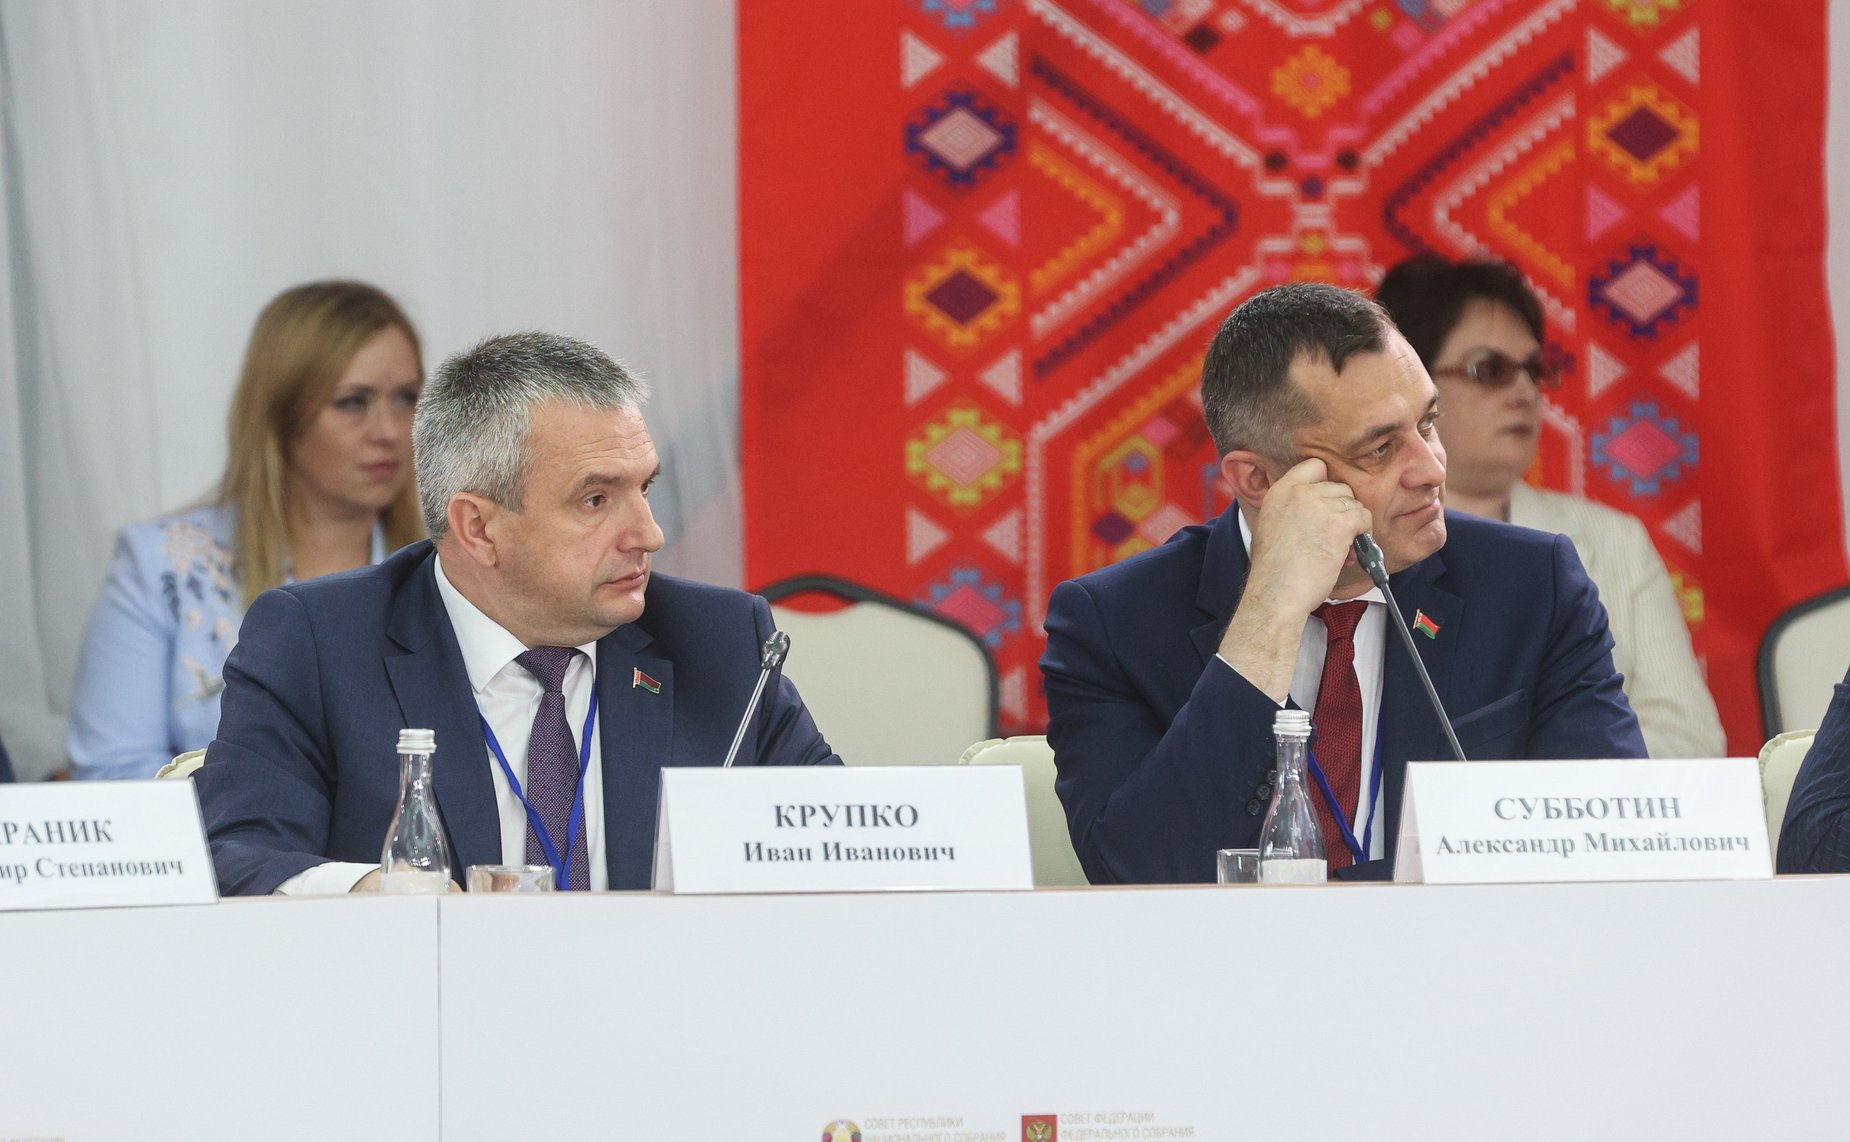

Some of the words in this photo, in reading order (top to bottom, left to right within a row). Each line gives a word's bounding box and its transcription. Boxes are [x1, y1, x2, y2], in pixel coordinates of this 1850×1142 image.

[773, 804, 919, 828] КРУПКО
[1494, 797, 1683, 821] СУББОТИН
[0, 819, 114, 844] РАНИК
[743, 841, 812, 862] Иван
[822, 840, 955, 862] Иванович
[1436, 835, 1576, 858] Александр
[1584, 832, 1751, 853] Михайлович
[36, 857, 184, 878] Степанович
[864, 1118, 894, 1130] СОВЕТ
[898, 1116, 964, 1129] РЕСПУБЛИКИ
[1060, 1112, 1090, 1124] СОВЕТ
[1094, 1111, 1154, 1123] ФЕДЕРАЦИИ
[1060, 1127, 1140, 1141] ФЕДЕРАЛЬНОГО
[1142, 1125, 1195, 1139] СОБРАНИЯ
